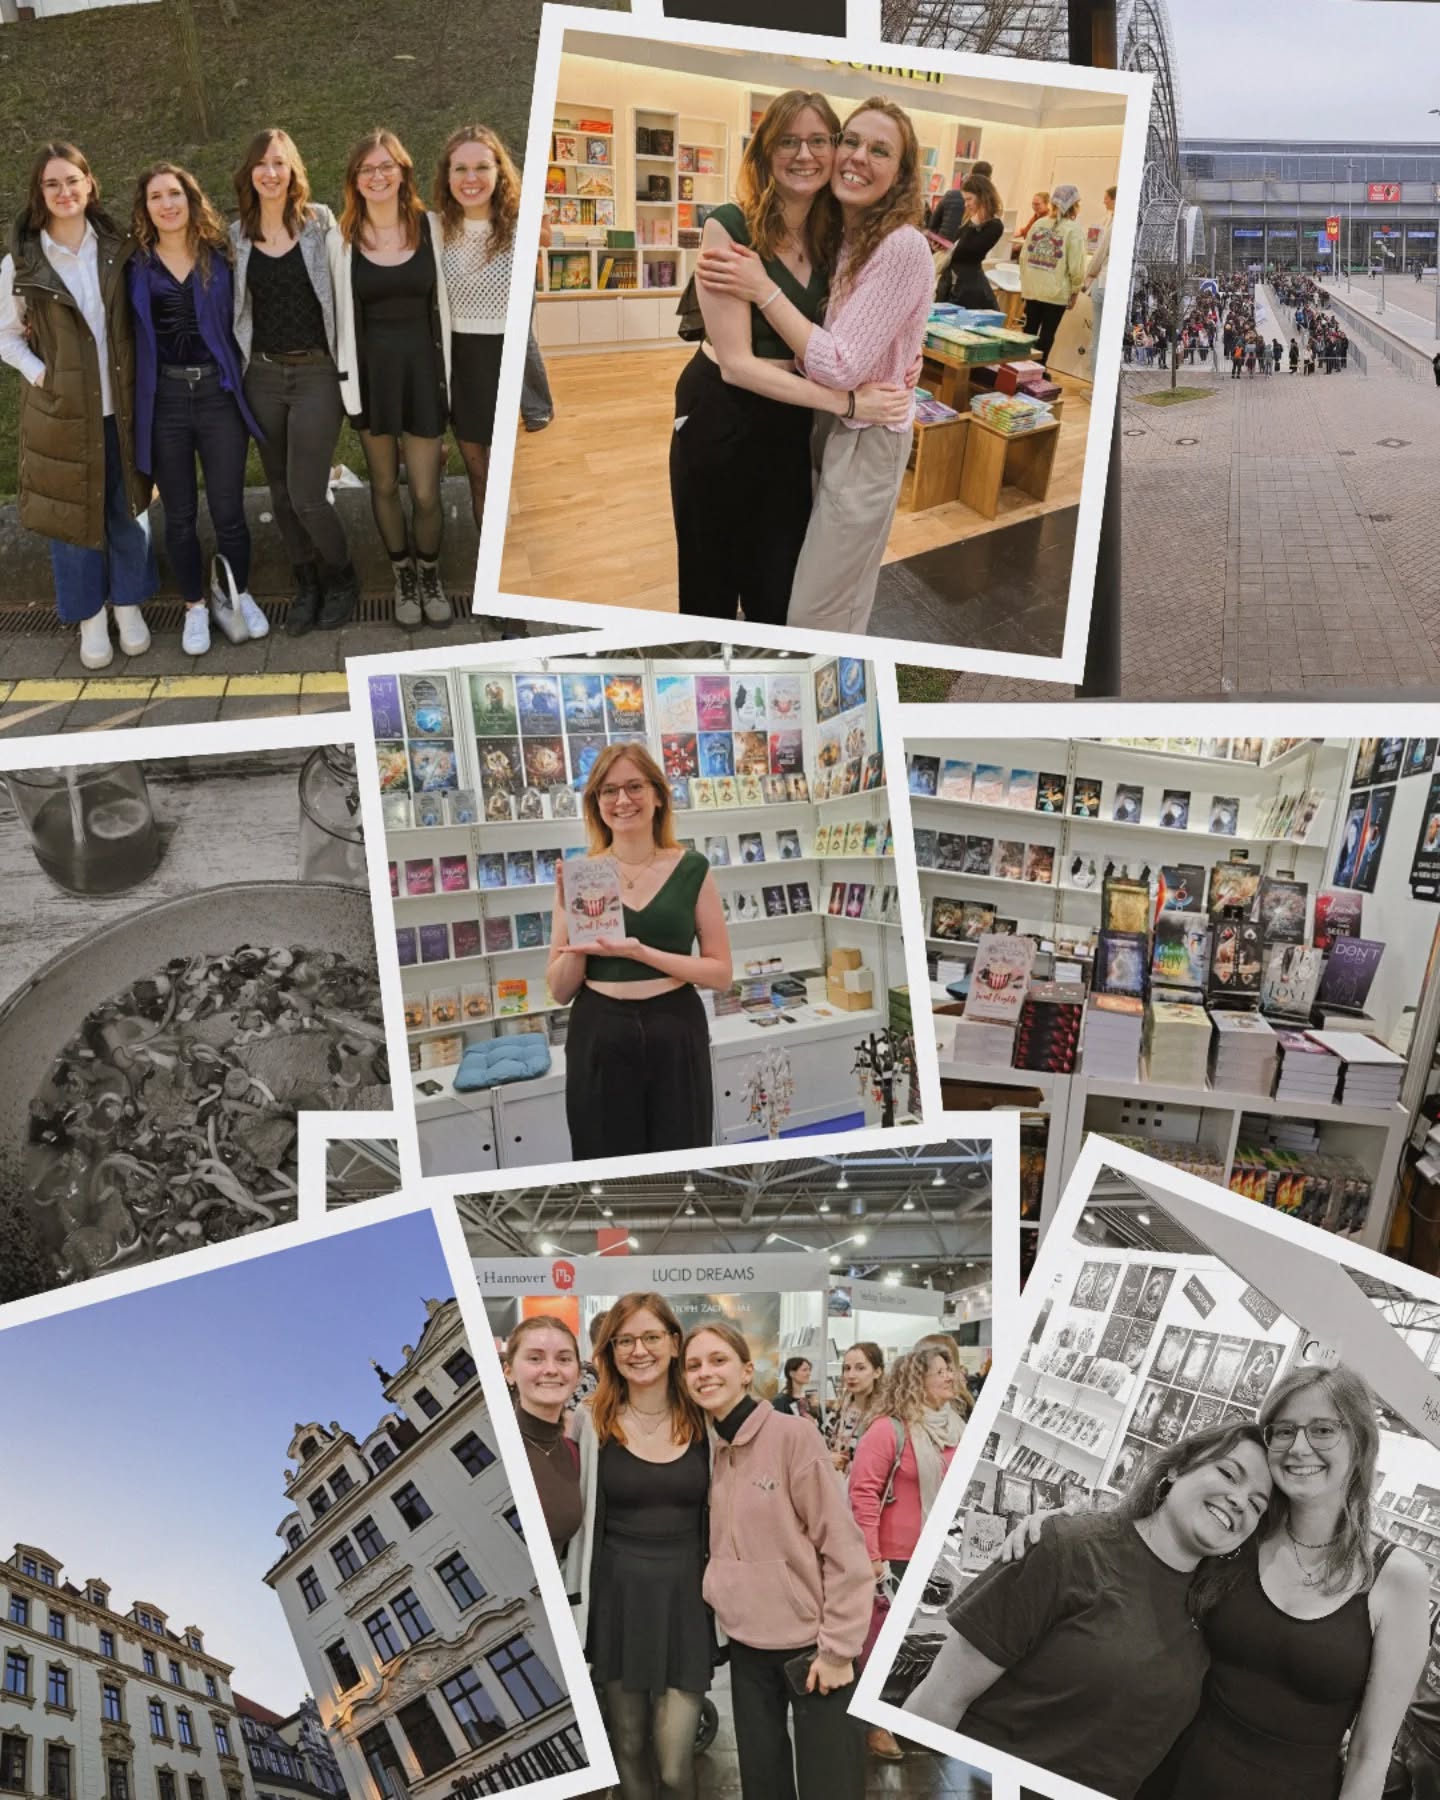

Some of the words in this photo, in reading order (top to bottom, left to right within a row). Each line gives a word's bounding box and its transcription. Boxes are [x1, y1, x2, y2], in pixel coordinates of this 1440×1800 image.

[484, 1271, 546, 1284] Hannover
[652, 1268, 692, 1282] LUCID
[696, 1266, 755, 1281] DREAMS
